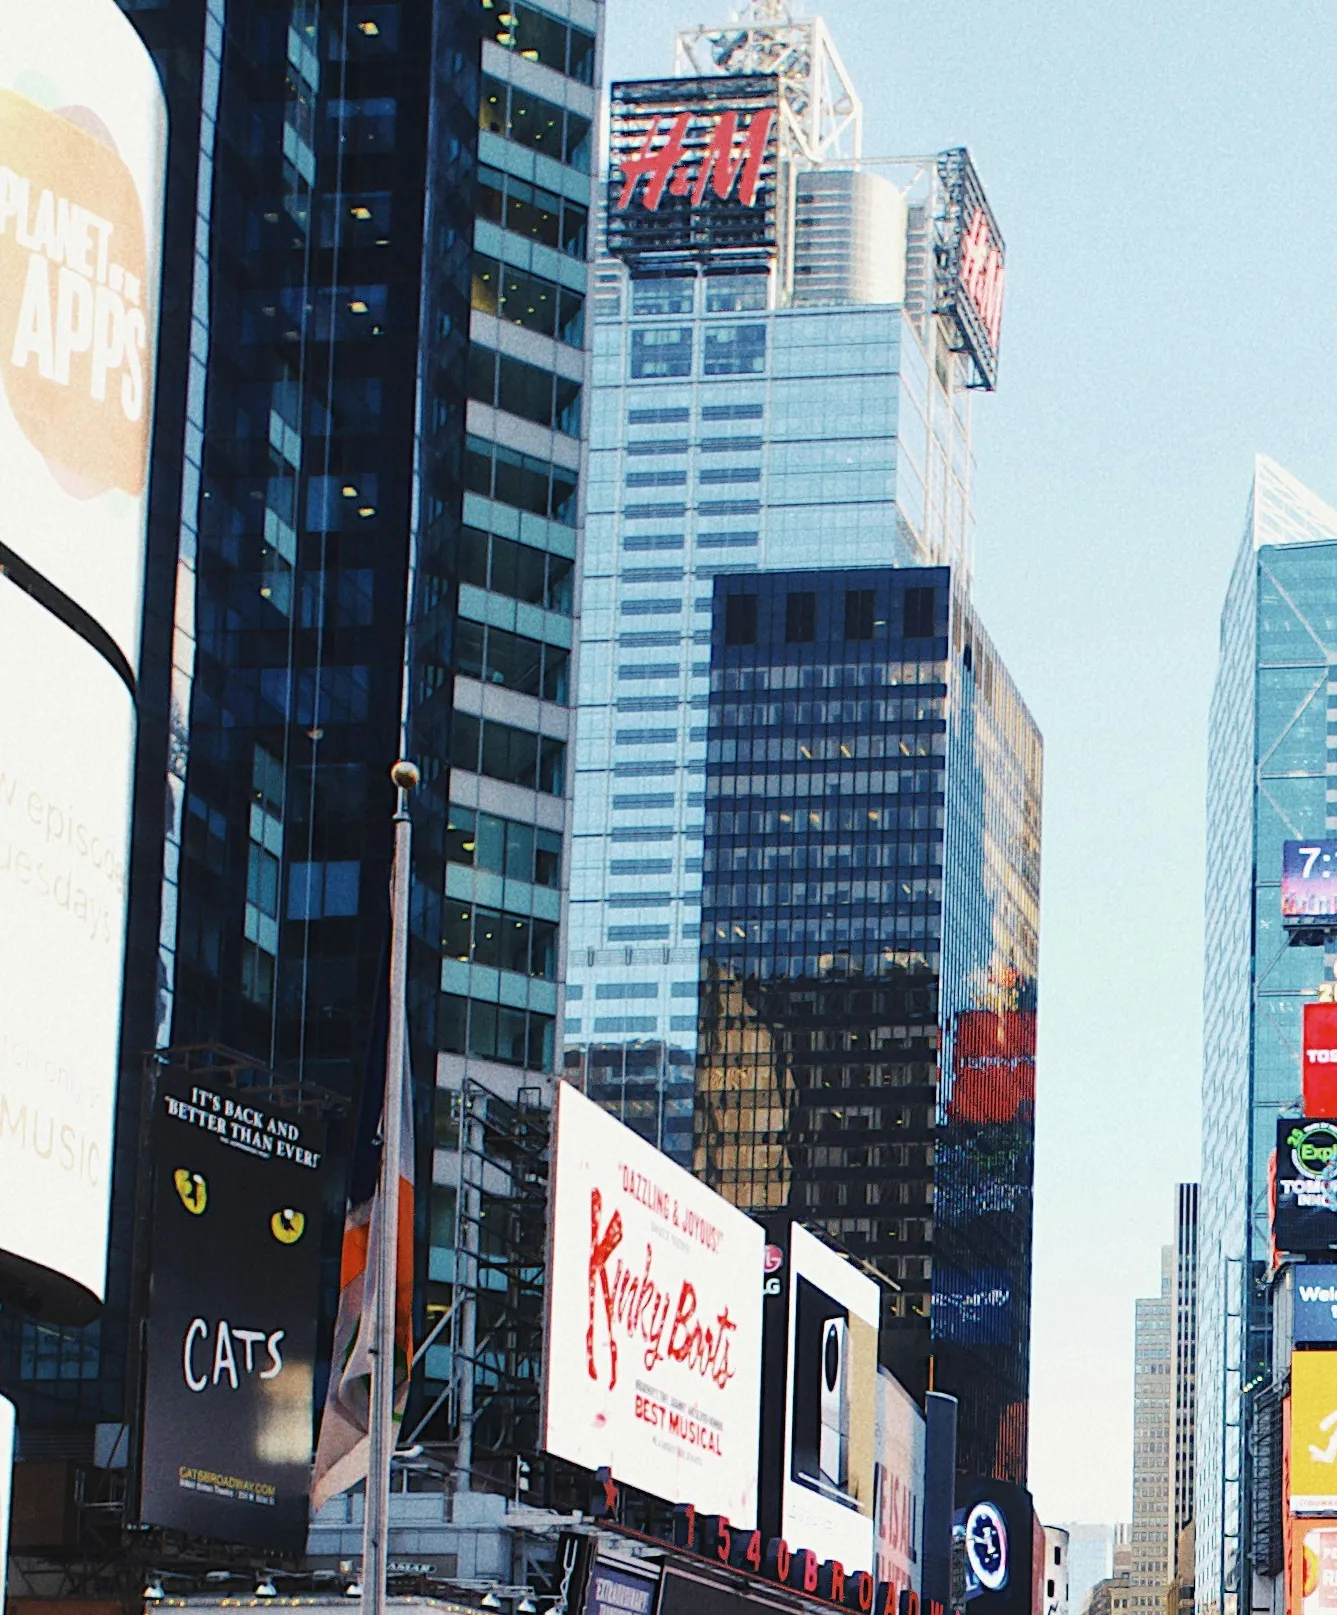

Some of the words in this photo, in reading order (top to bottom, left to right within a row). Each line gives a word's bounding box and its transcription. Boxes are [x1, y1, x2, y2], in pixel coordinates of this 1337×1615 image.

[618, 108, 773, 212] H&M
[0, 166, 114, 284] PLANET
[11, 253, 146, 421] APPS
[192, 1087, 221, 1112] IT'S
[224, 1100, 264, 1129] BACK
[267, 1118, 299, 1142] AND
[231, 1122, 273, 1153] THAN
[184, 1318, 285, 1392] CATS
[667, 1280, 738, 1390] Boots
[635, 1394, 667, 1432] BEST
[667, 1410, 723, 1457] MUSICAL
[684, 1503, 791, 1584] 1540
